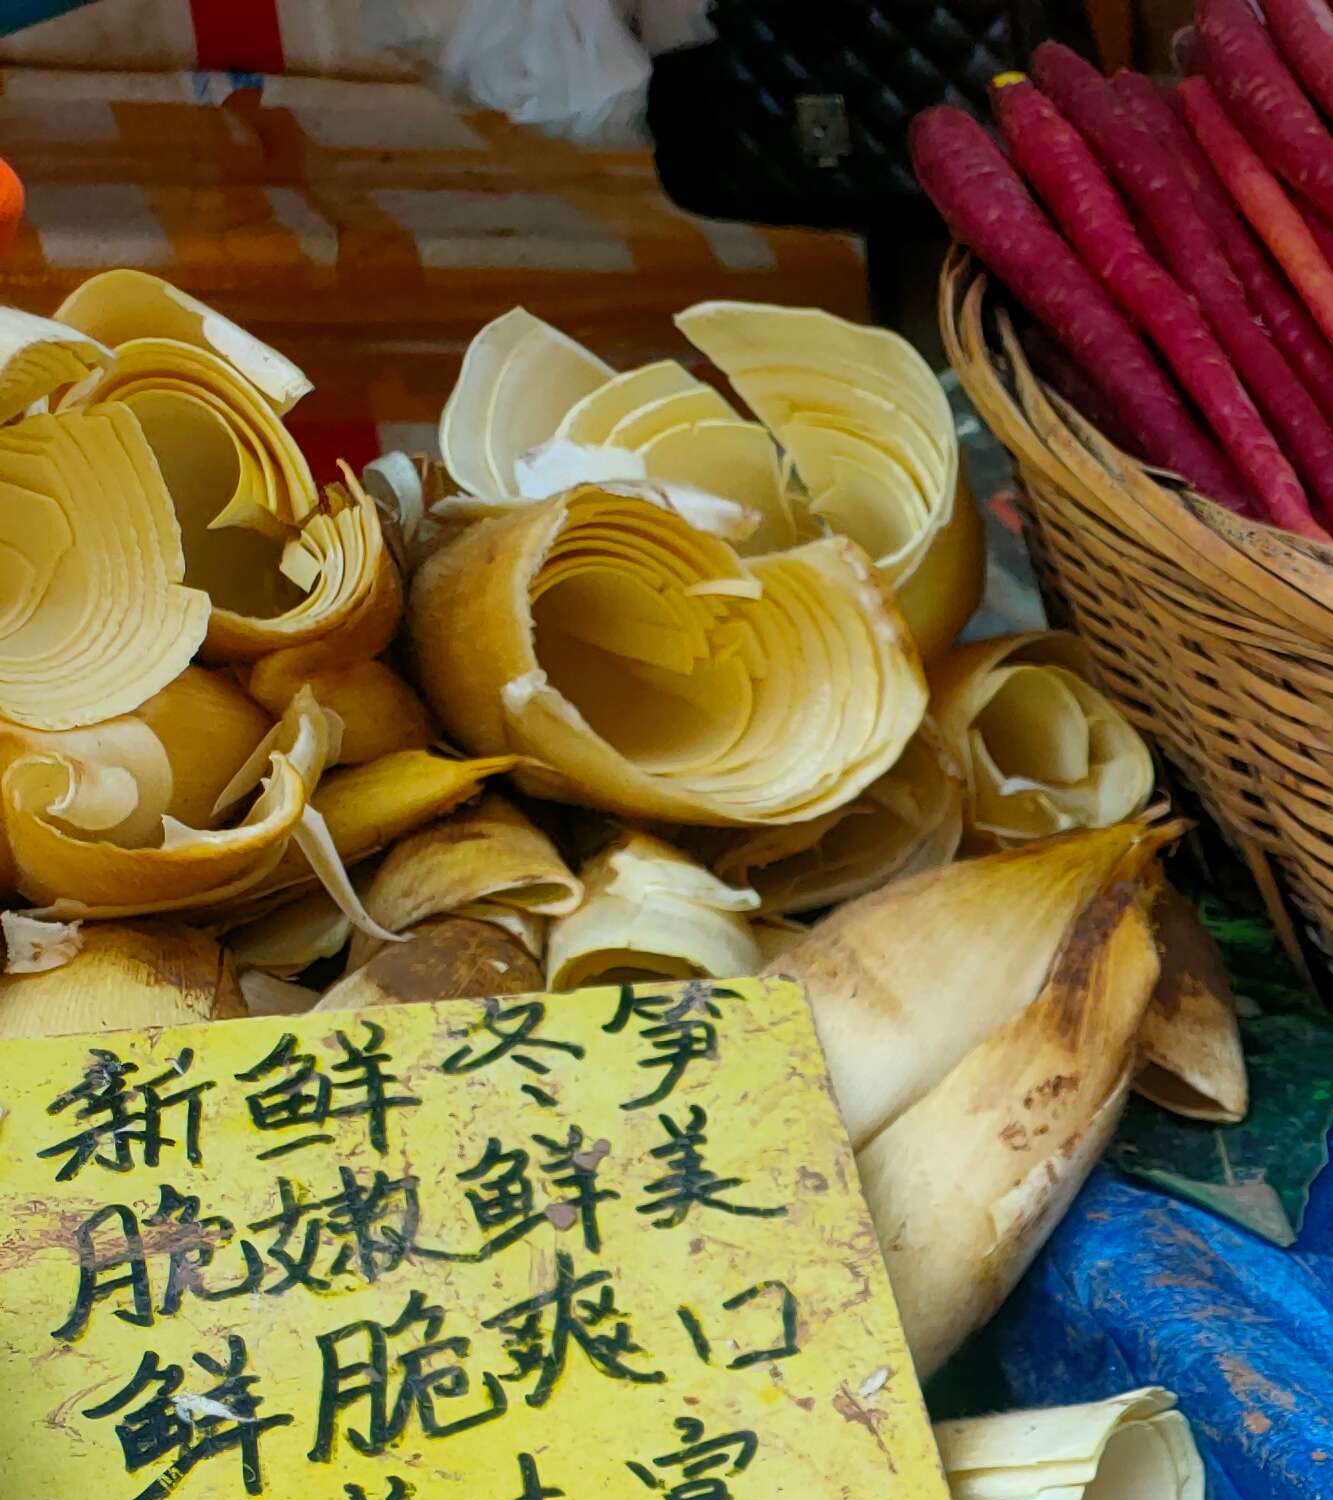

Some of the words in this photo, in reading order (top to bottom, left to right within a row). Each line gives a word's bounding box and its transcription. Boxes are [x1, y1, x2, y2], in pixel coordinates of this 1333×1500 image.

[36, 984, 745, 1183] 新鲜冬笋
[51, 1103, 788, 1342] 脆嫩鲜美
